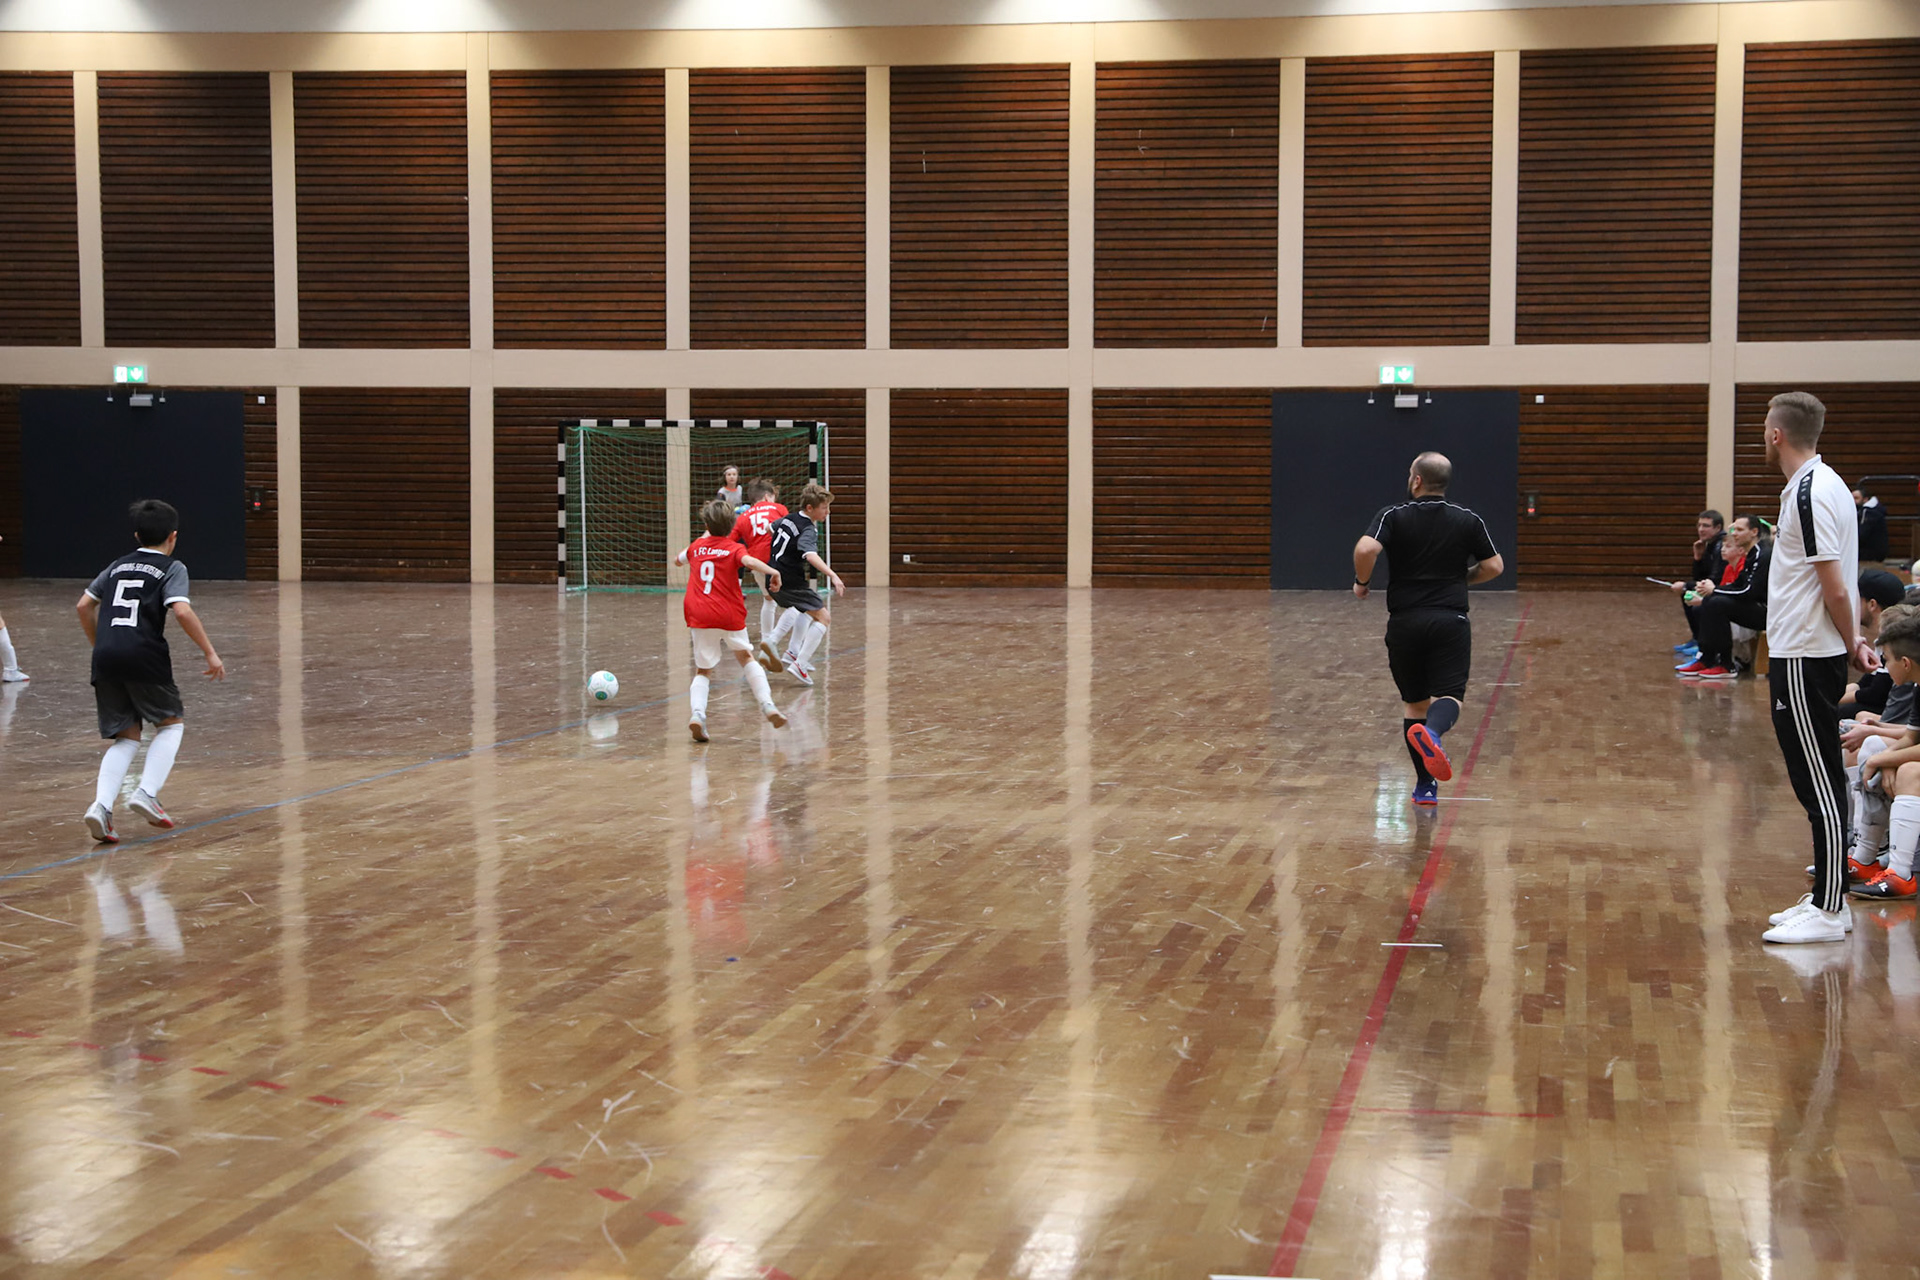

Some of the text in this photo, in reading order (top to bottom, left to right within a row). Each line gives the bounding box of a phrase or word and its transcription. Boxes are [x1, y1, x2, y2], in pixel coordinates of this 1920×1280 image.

[749, 511, 770, 537] 15
[698, 546, 707, 556] FC
[707, 547, 730, 558] Langen
[700, 560, 715, 595] 9
[111, 579, 145, 627] 5
